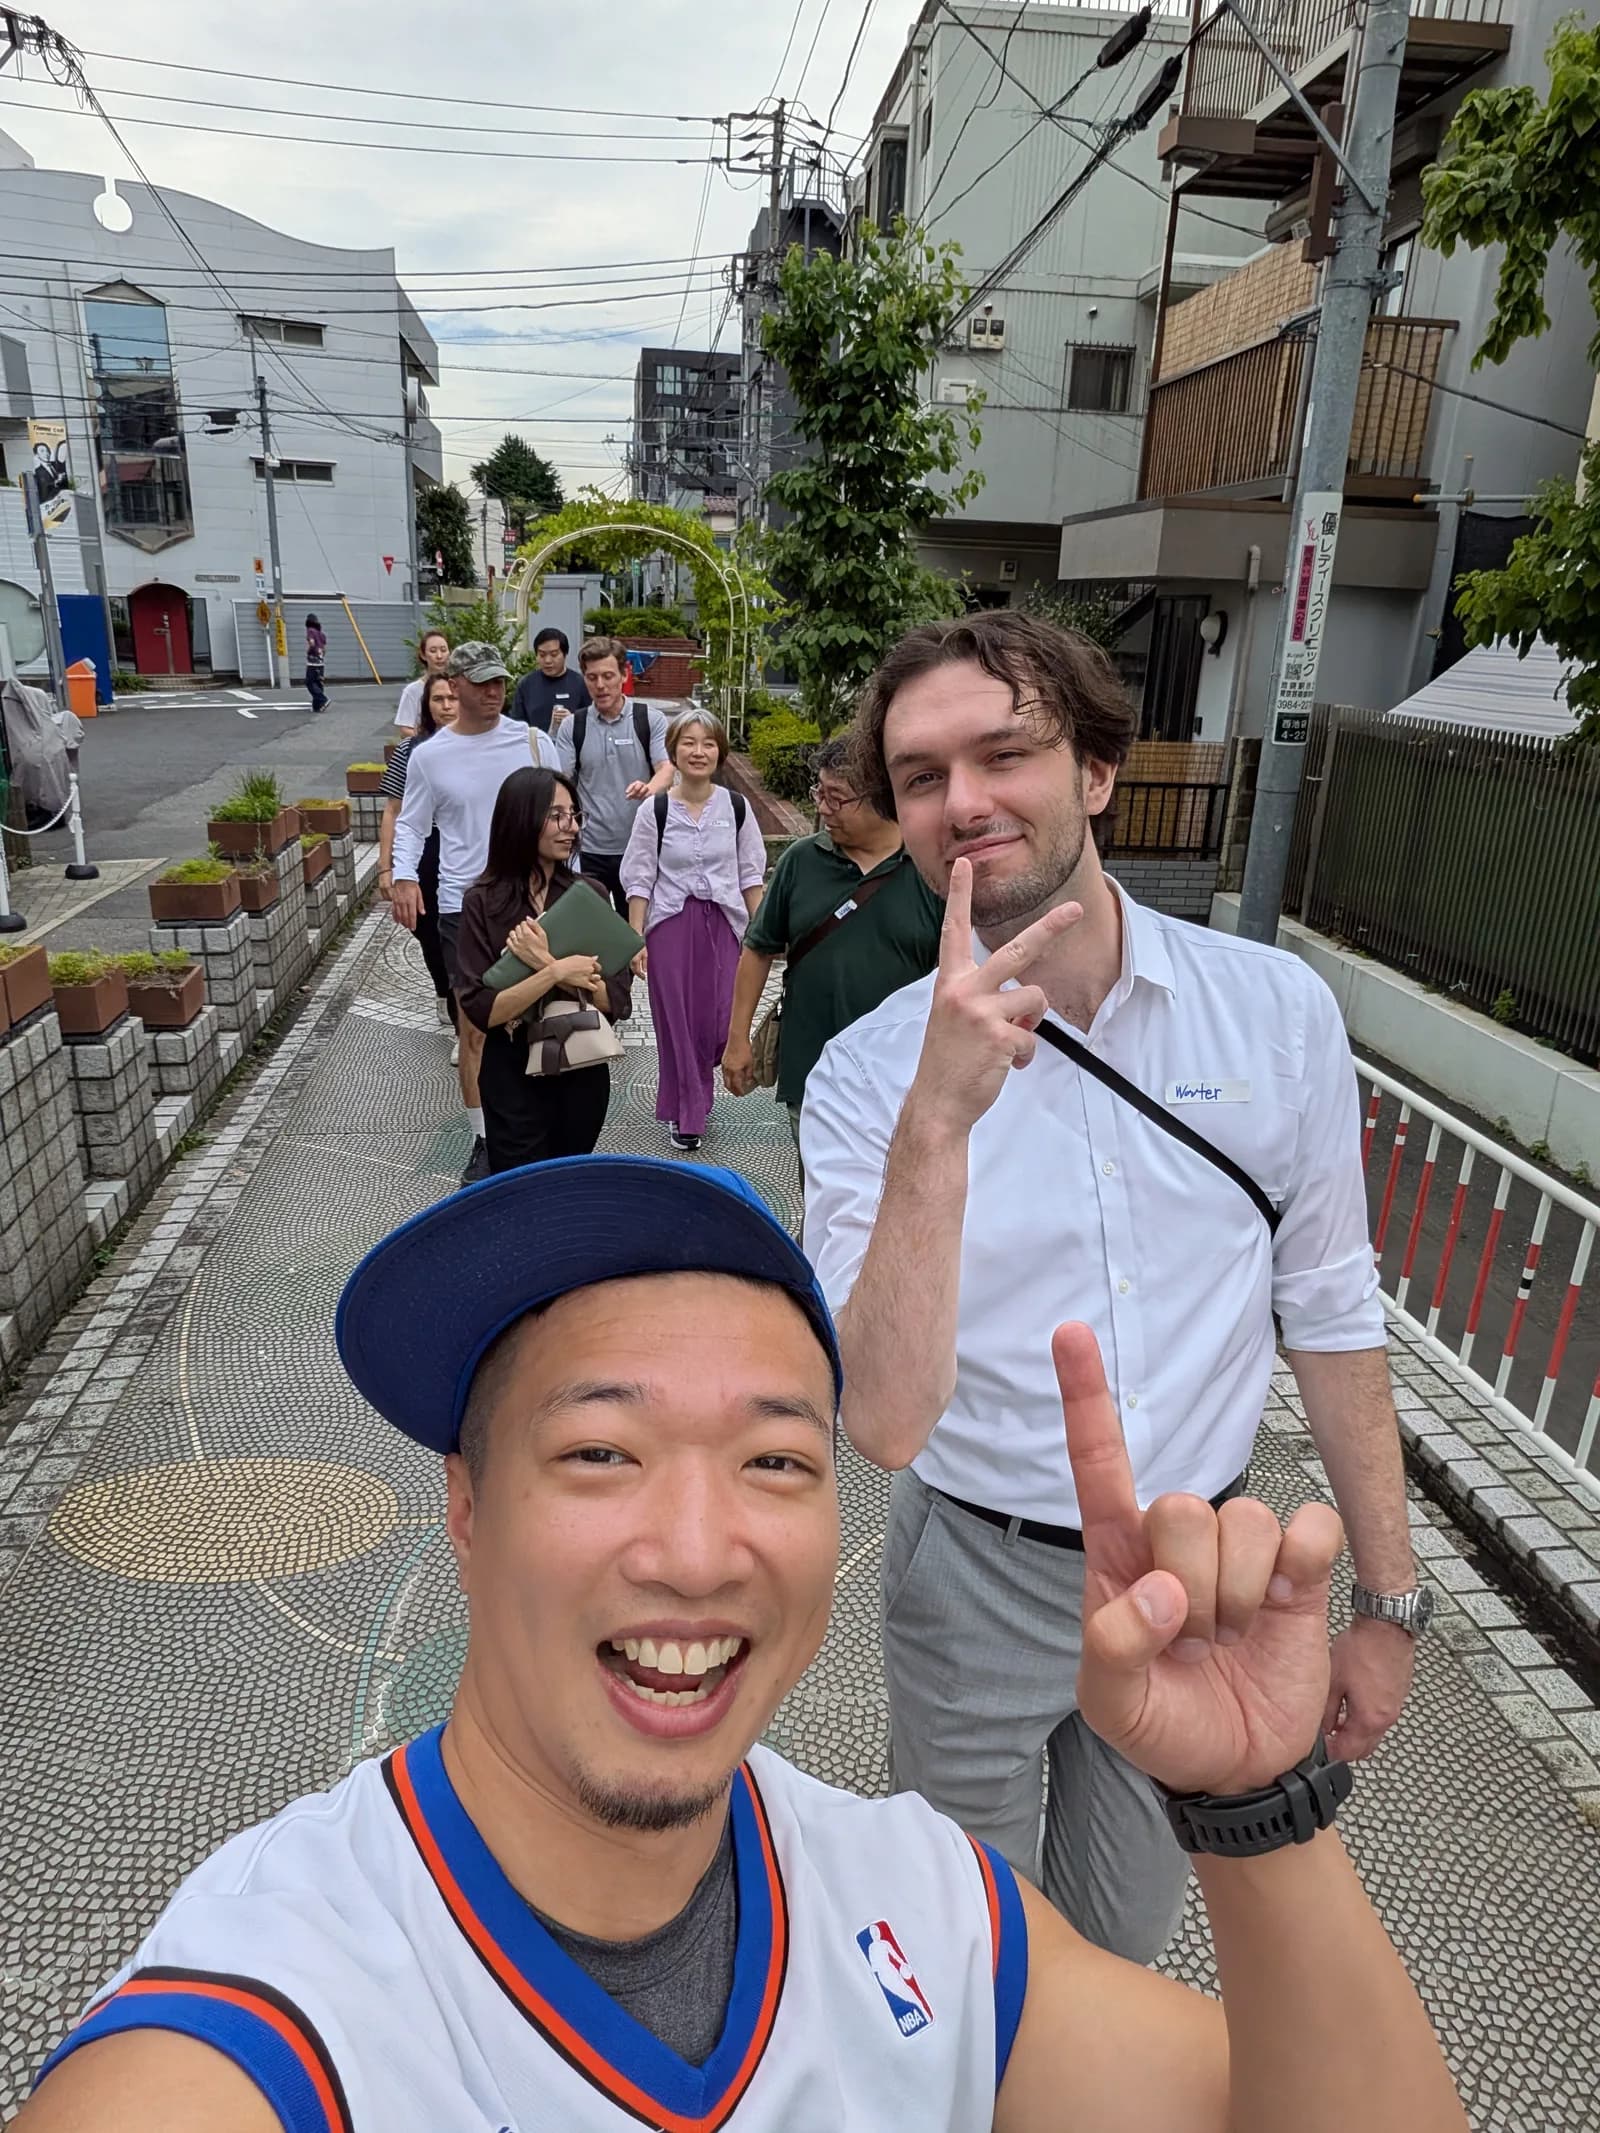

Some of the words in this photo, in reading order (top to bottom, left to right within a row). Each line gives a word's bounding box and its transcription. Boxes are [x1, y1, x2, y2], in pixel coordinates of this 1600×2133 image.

[1302, 511, 1339, 678] 優レディースクリニック
[898, 2008, 924, 2033] NBA
